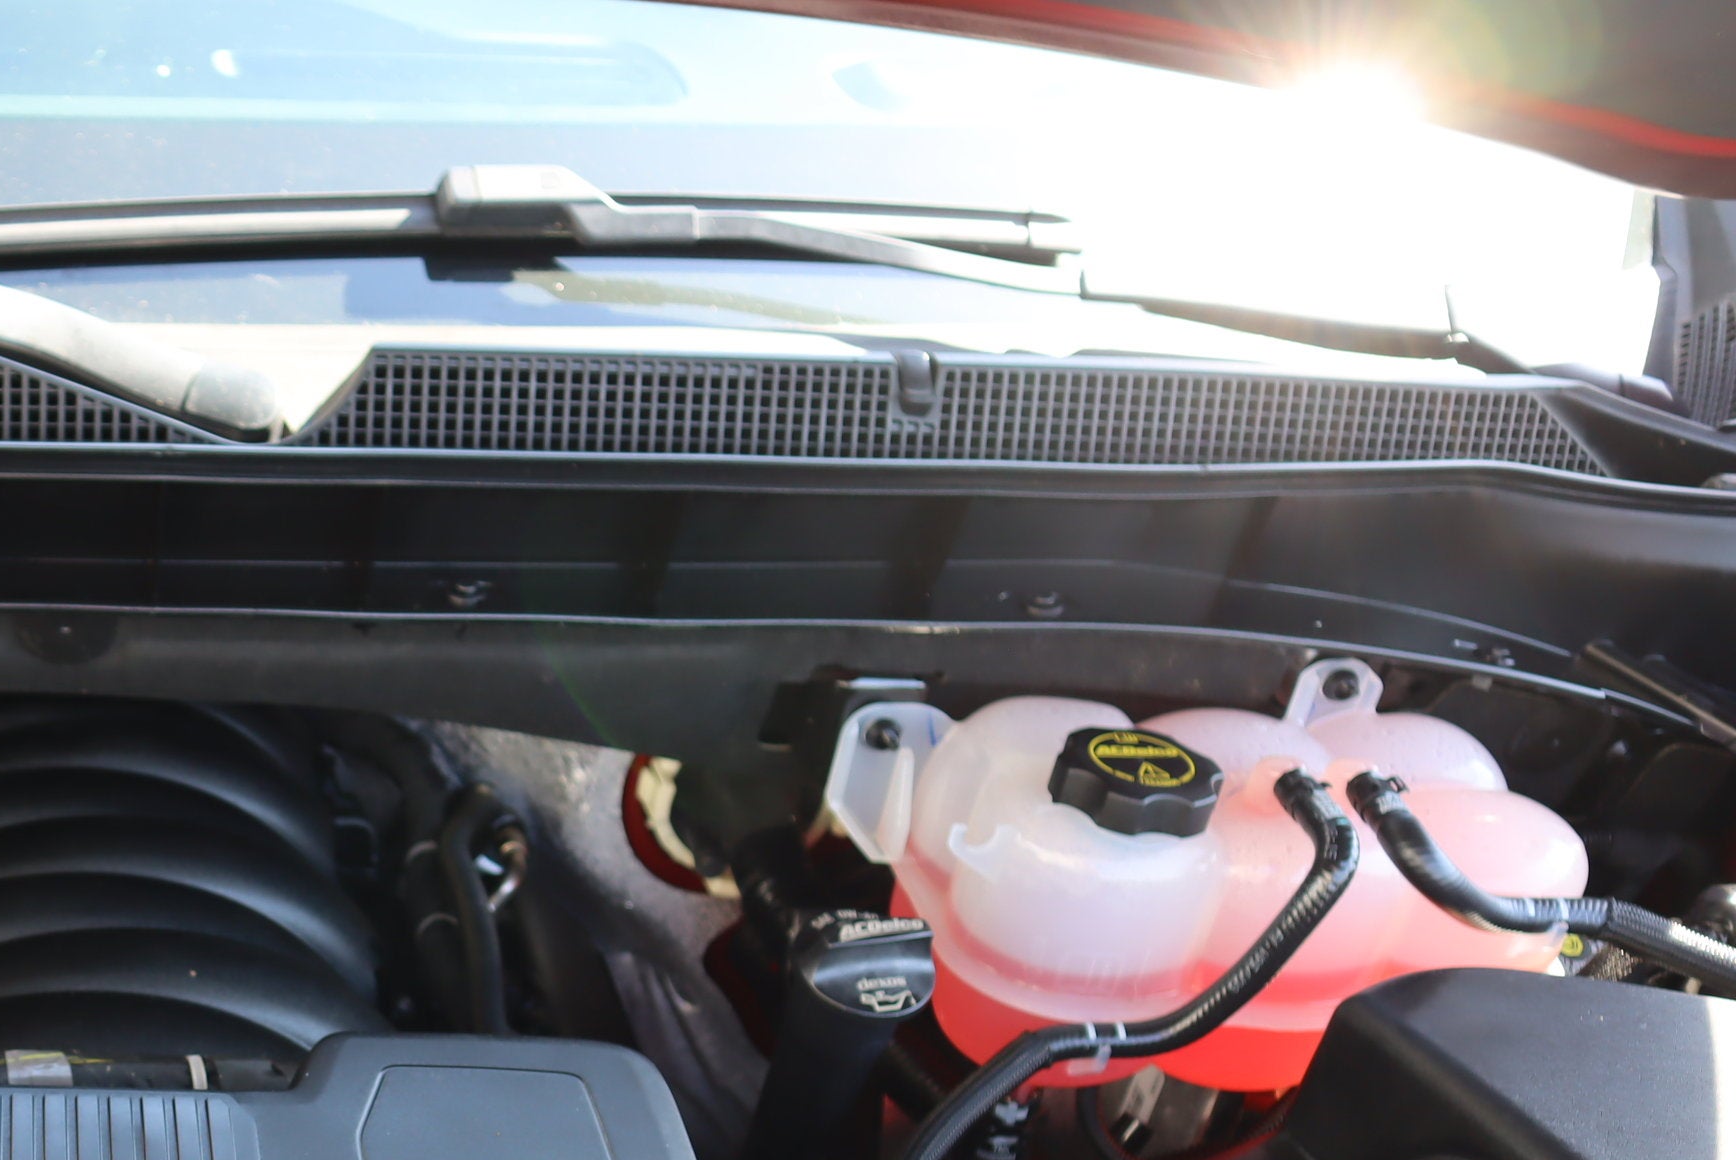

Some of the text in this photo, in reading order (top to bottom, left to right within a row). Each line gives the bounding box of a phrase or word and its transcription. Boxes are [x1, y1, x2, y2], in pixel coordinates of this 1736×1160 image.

[1095, 744, 1179, 758] ACDelco
[839, 917, 924, 943] ACDelco
[857, 975, 907, 991] dexos
